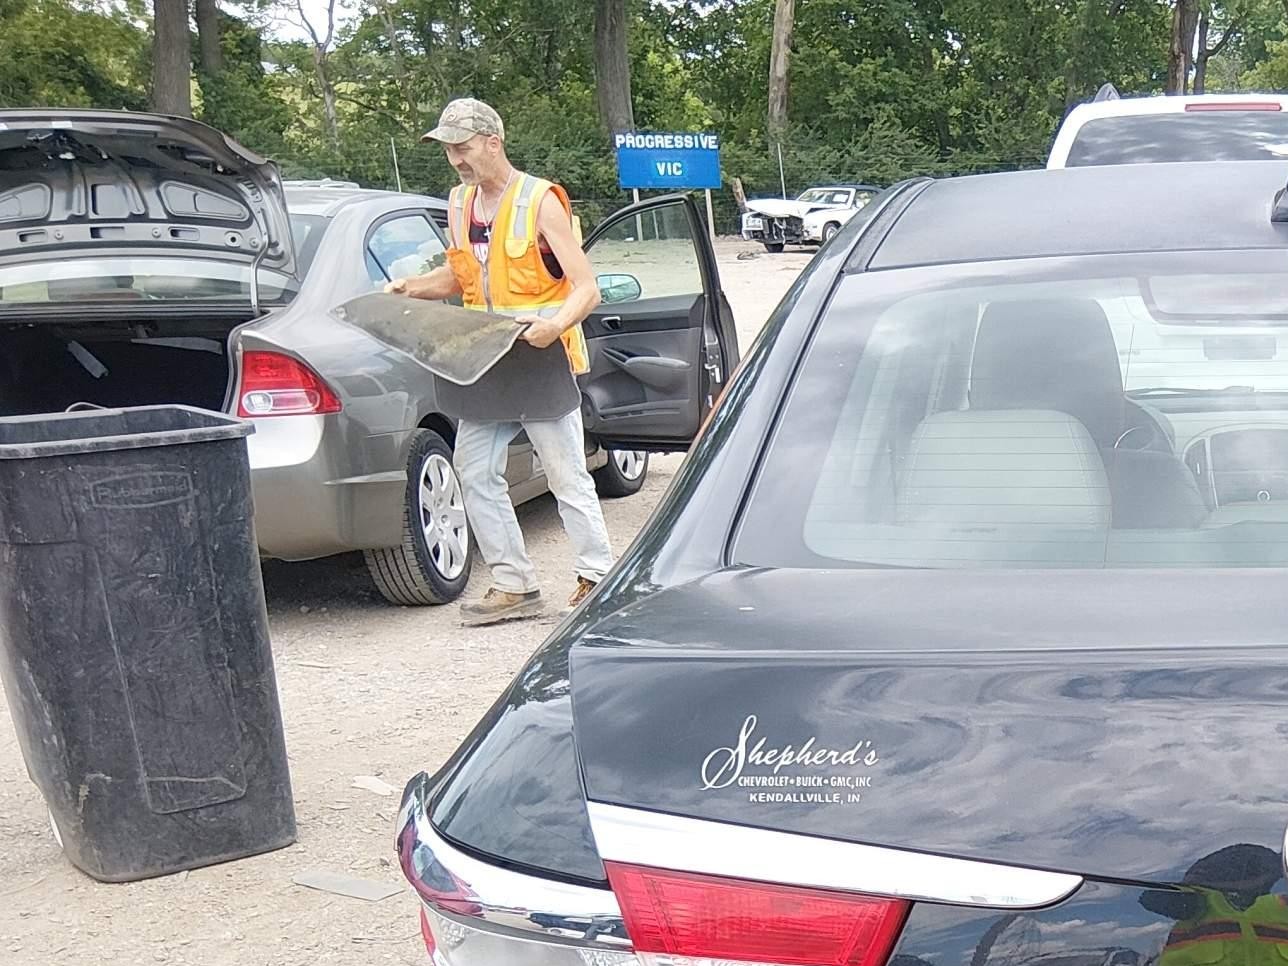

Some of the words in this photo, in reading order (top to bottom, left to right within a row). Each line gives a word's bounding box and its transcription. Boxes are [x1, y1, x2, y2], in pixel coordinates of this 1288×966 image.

[615, 133, 719, 150] PROGRESSIVE
[656, 162, 683, 176] VIC
[700, 714, 880, 791] Shepherd's
[750, 792, 844, 804] KENDALLVILLE,
[847, 793, 860, 803] IN
